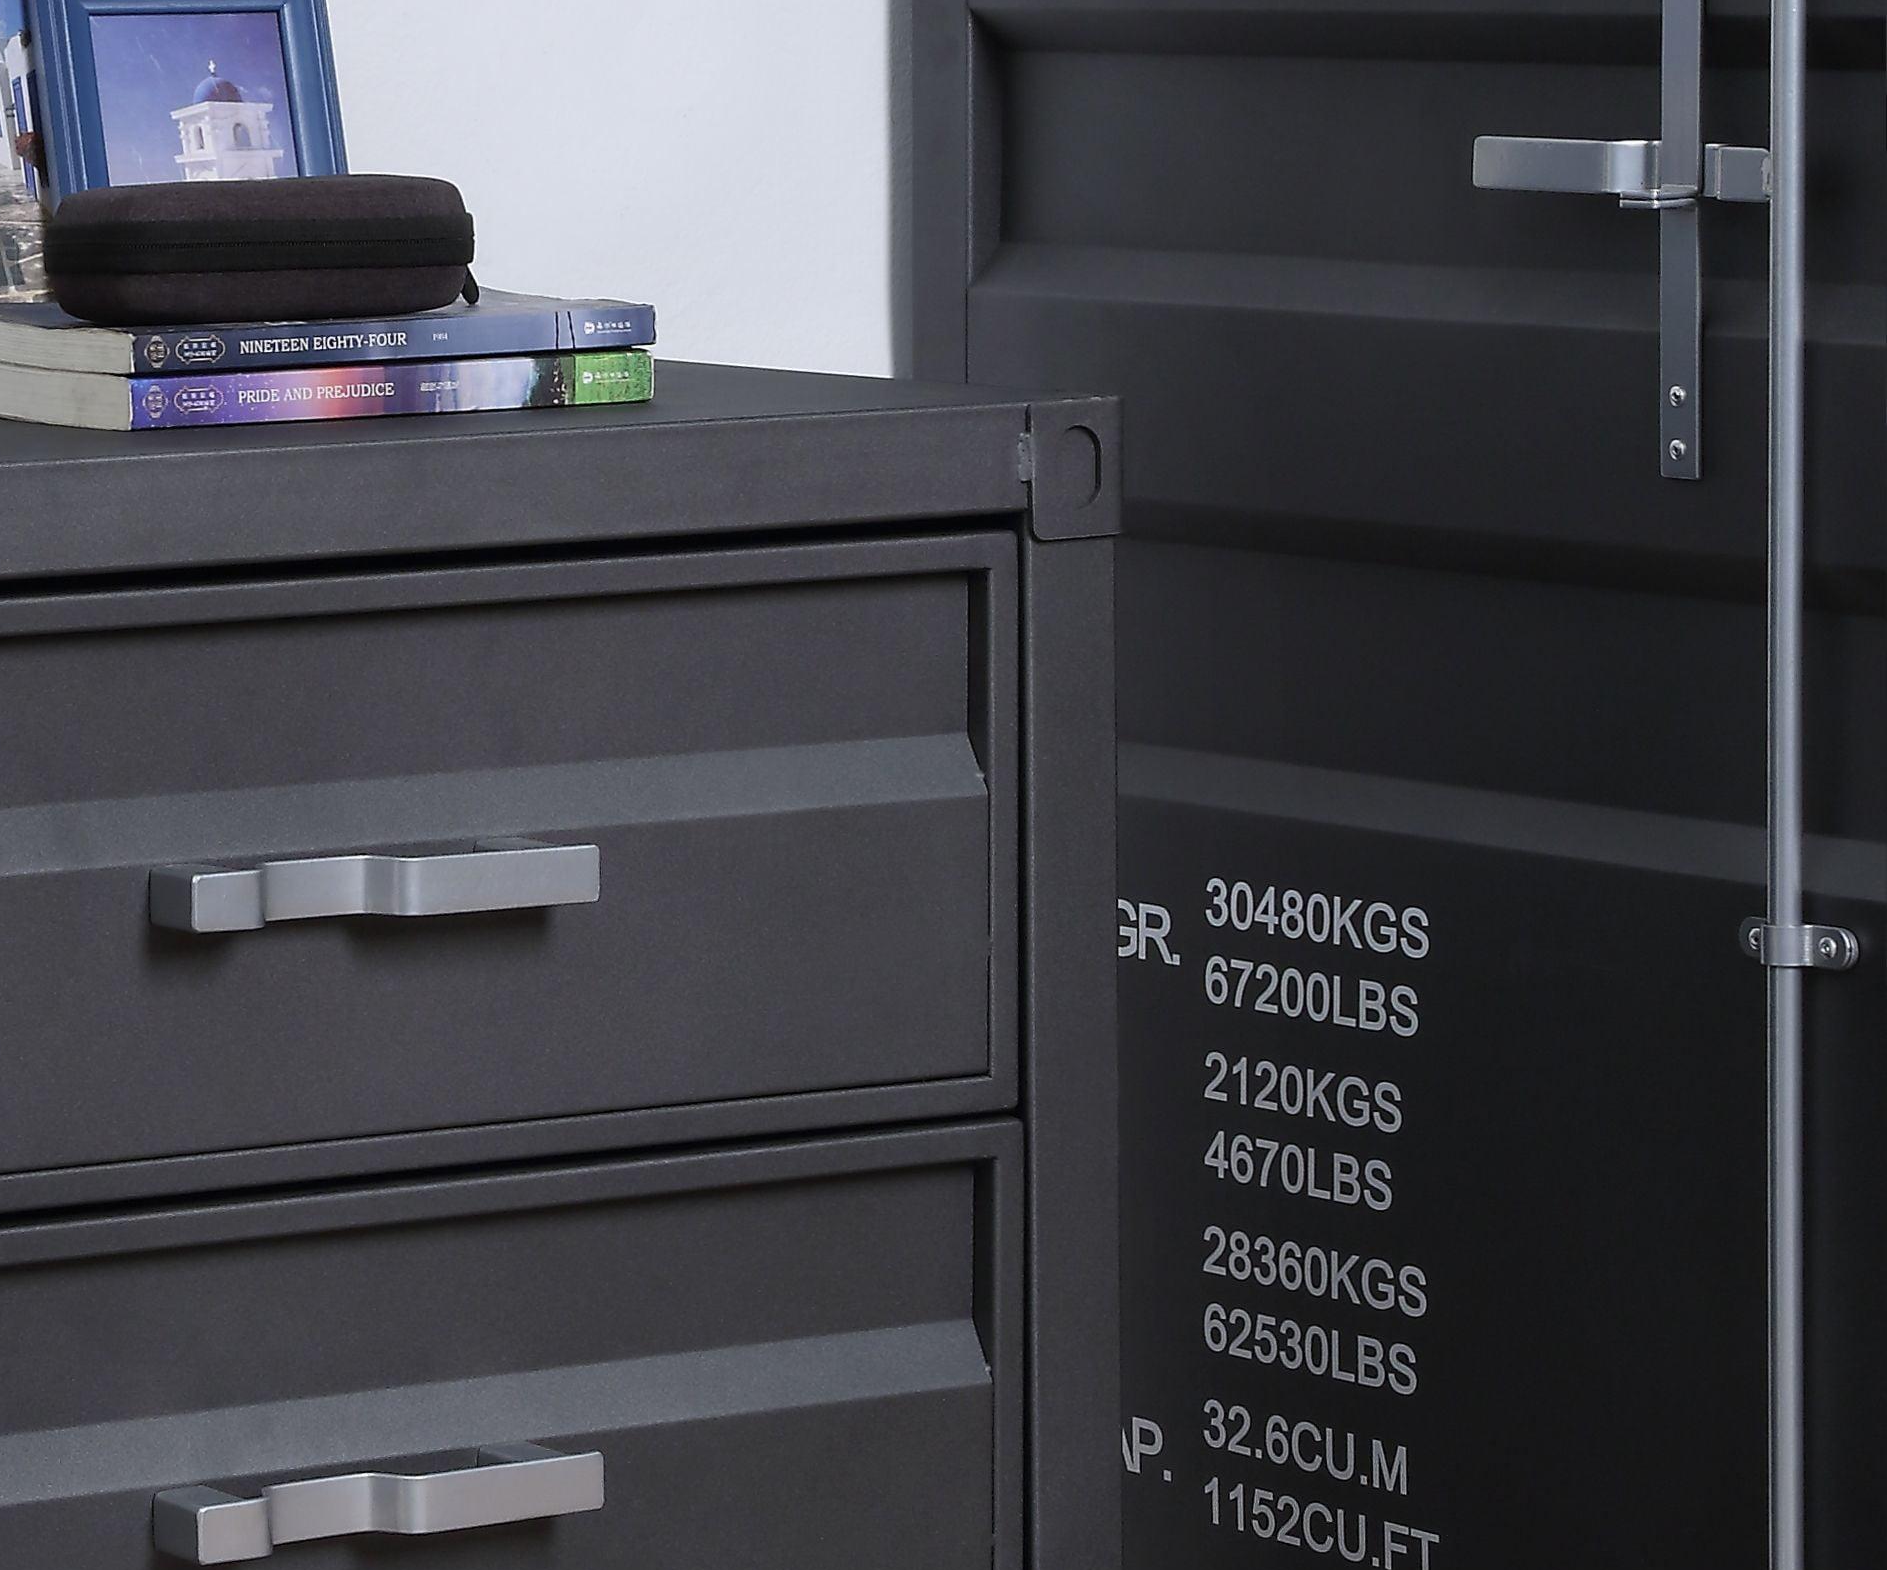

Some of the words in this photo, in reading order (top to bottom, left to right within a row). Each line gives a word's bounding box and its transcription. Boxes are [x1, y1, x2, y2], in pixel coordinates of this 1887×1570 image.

[239, 337, 309, 355] NINETEEN
[313, 332, 408, 351] EIGHTY-FOUR
[238, 389, 280, 404] PRIDE
[283, 388, 313, 402] AND
[316, 382, 395, 399] PREJUDICE
[1205, 876, 1430, 959] 30480KGS
[1204, 955, 1419, 1037] 67200LBS
[1204, 1051, 1403, 1134] 2120KGS
[1204, 1130, 1393, 1212] 4670LBS
[1202, 1225, 1428, 1318] 28360KGS
[1203, 1302, 1418, 1395] 62530LBS
[1203, 1398, 1408, 1496] 32.6CU.M
